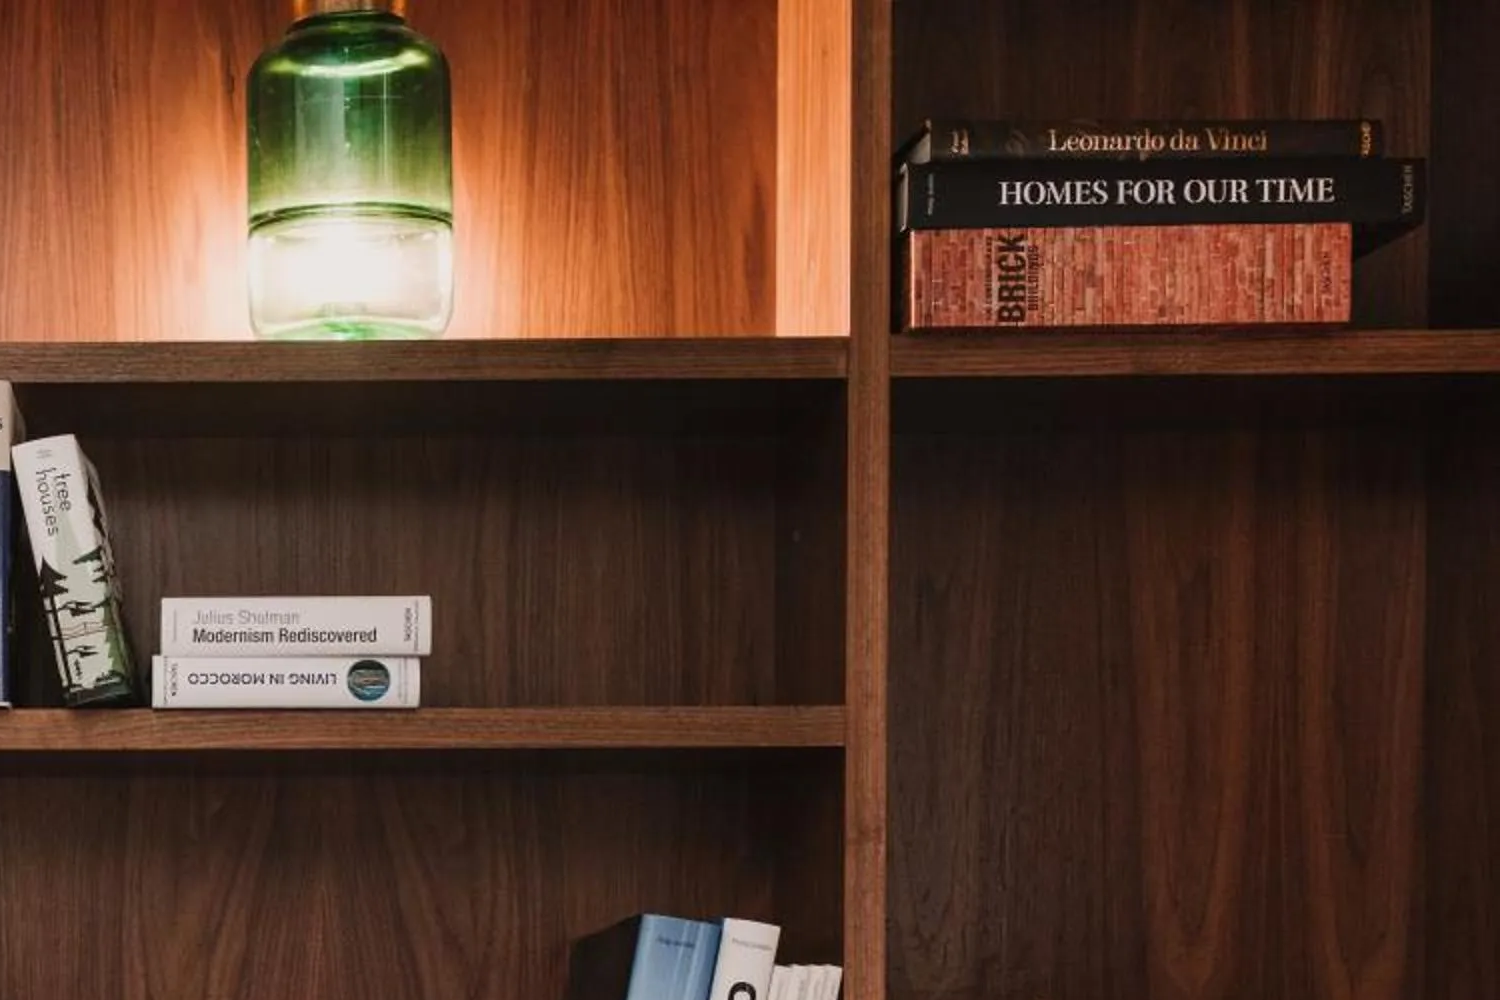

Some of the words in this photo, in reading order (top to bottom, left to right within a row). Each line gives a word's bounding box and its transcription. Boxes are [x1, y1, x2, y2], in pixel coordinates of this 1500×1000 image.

[1048, 128, 1165, 152] Leonardo
[1170, 128, 1200, 151] da
[1204, 127, 1268, 151] Vinci
[998, 180, 1109, 206] HOMES
[1116, 179, 1176, 205] FOR
[1183, 178, 1250, 205] OUR
[1255, 177, 1335, 204] TIME
[1401, 165, 1414, 214] TASCHEN
[998, 233, 1027, 323] BRICK
[36, 466, 59, 537] houses
[54, 473, 73, 512] tree
[192, 610, 235, 626] Julius
[238, 610, 300, 626] Shulman
[192, 627, 275, 644] Modernism
[278, 626, 378, 644] Rediscovered
[188, 671, 265, 685] MOROCCO
[269, 672, 285, 685] IN
[289, 672, 337, 686] LIVING
